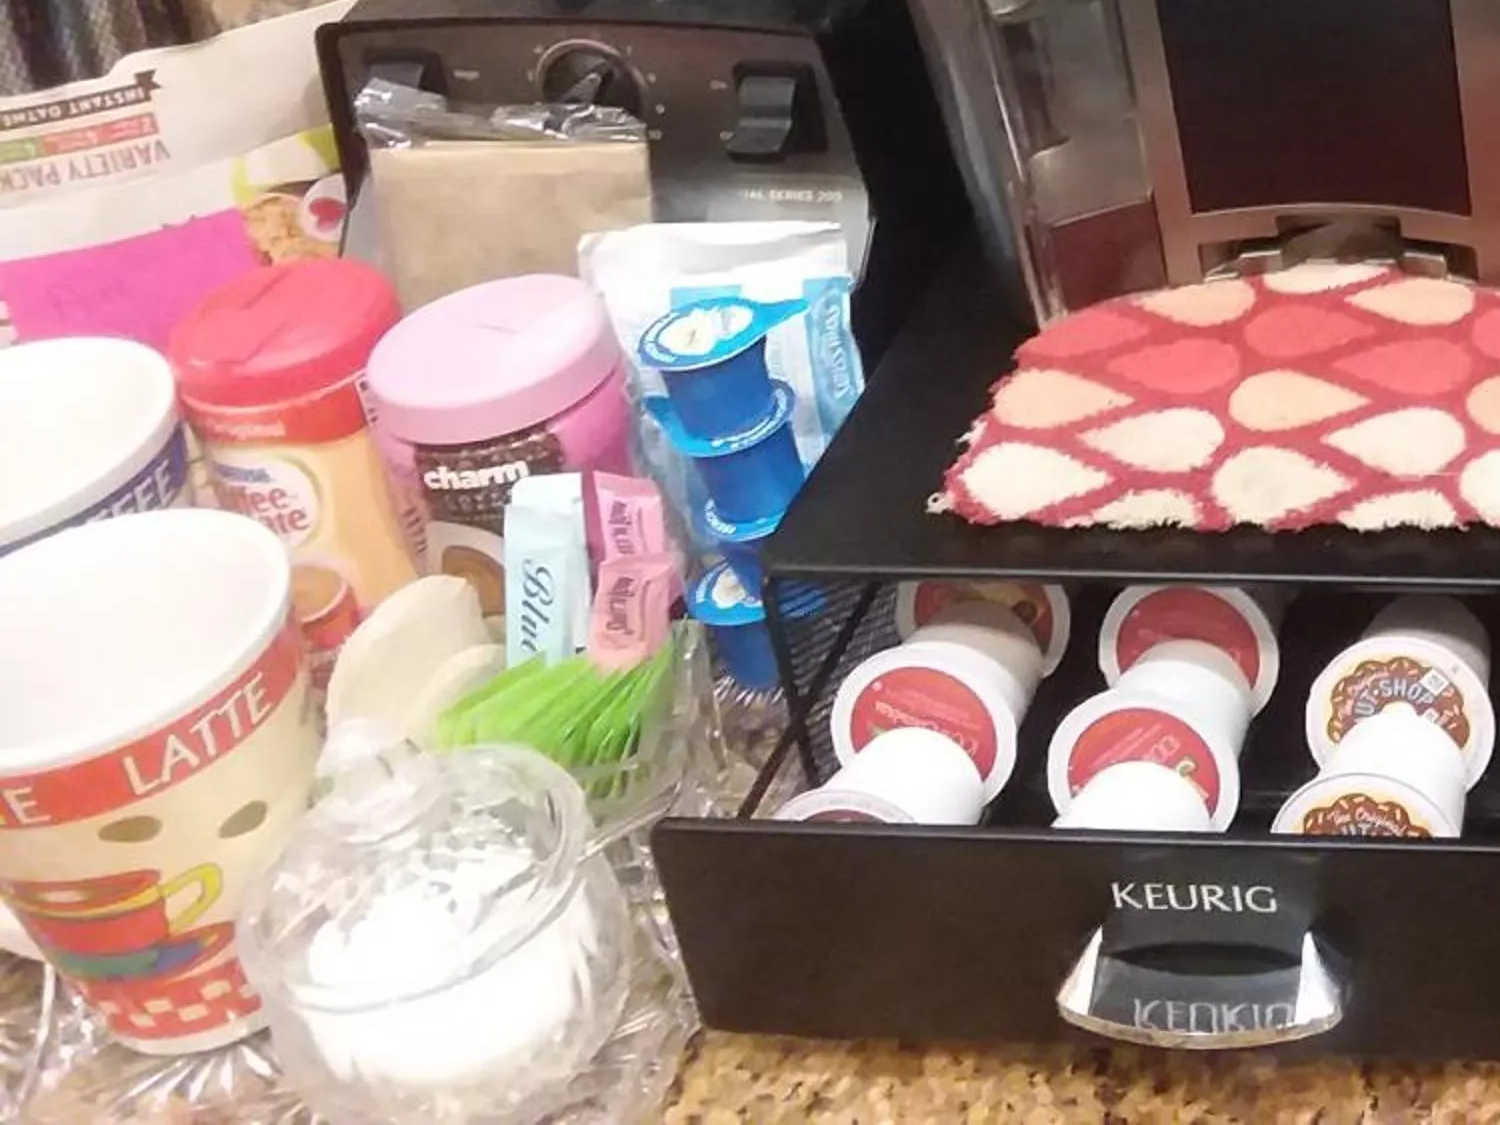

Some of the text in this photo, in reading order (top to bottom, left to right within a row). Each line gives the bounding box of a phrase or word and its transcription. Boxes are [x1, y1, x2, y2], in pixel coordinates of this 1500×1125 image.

[69, 86, 145, 113] INSTANT
[69, 139, 171, 181] VARIETY
[423, 459, 530, 490] charm
[121, 671, 273, 796] LATTE
[1111, 881, 1278, 913] KEURIG
